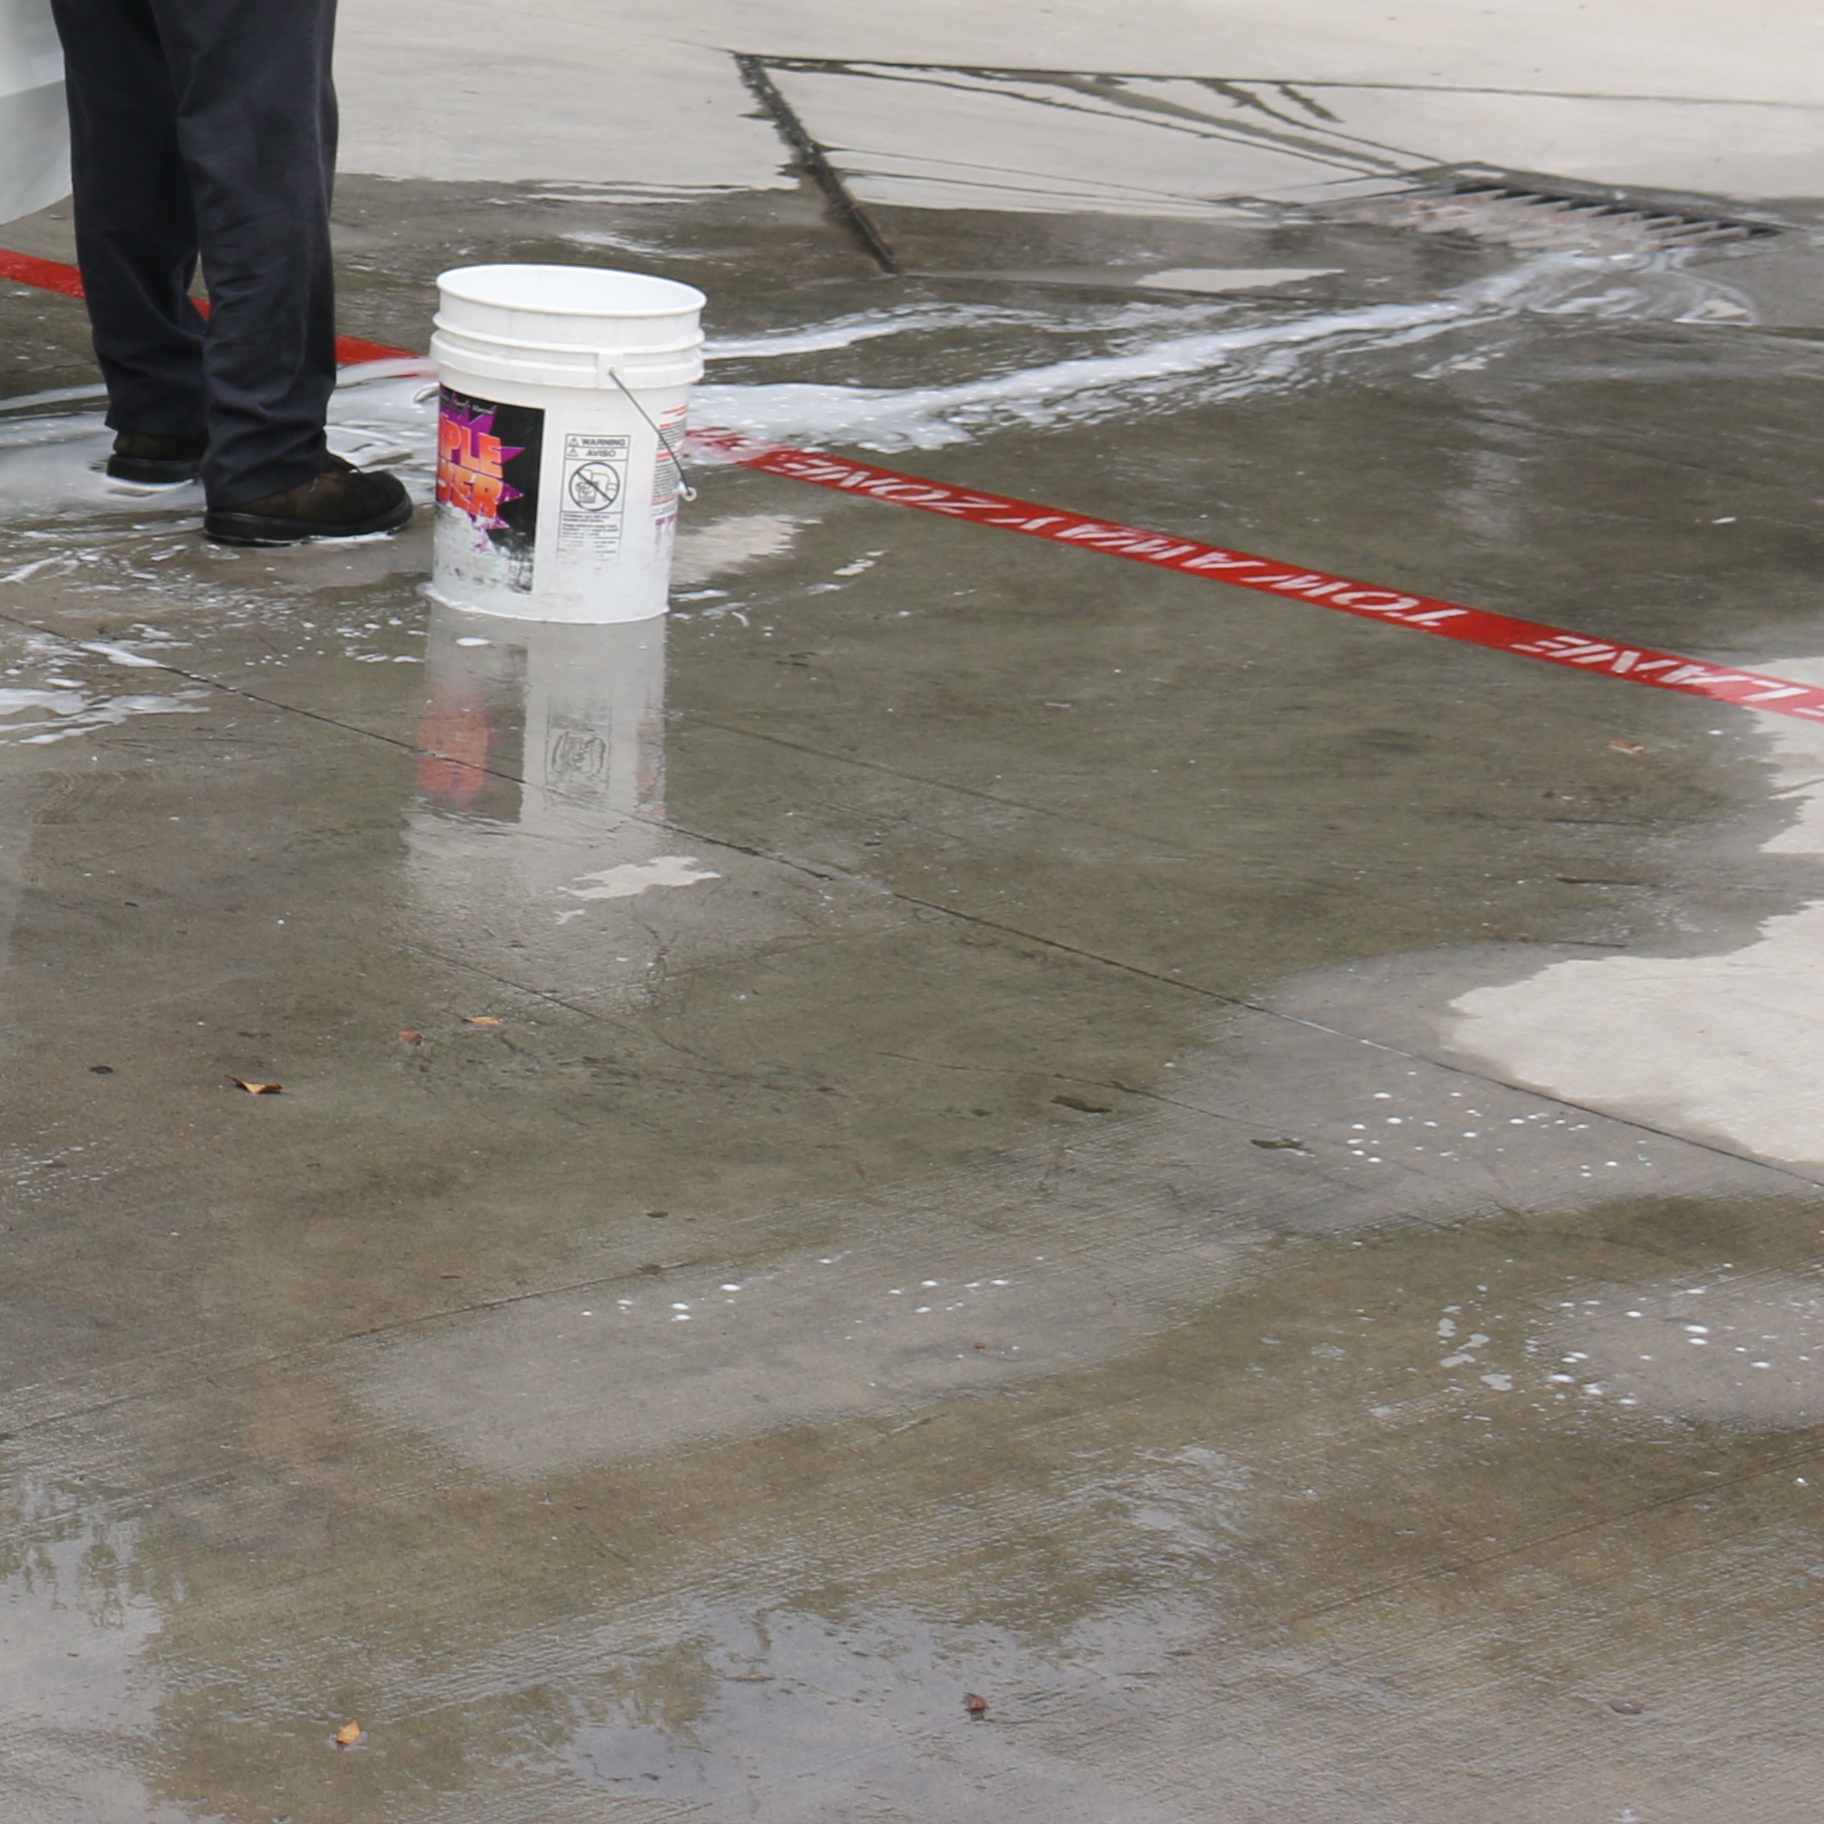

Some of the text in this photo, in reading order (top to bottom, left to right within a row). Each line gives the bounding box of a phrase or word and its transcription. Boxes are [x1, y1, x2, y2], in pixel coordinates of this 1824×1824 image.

[581, 438, 625, 447] WARNING
[586, 448, 616, 458] AVISO
[762, 456, 1469, 627] TOW AWAY ZONE
[1509, 635, 1812, 702] LANE
